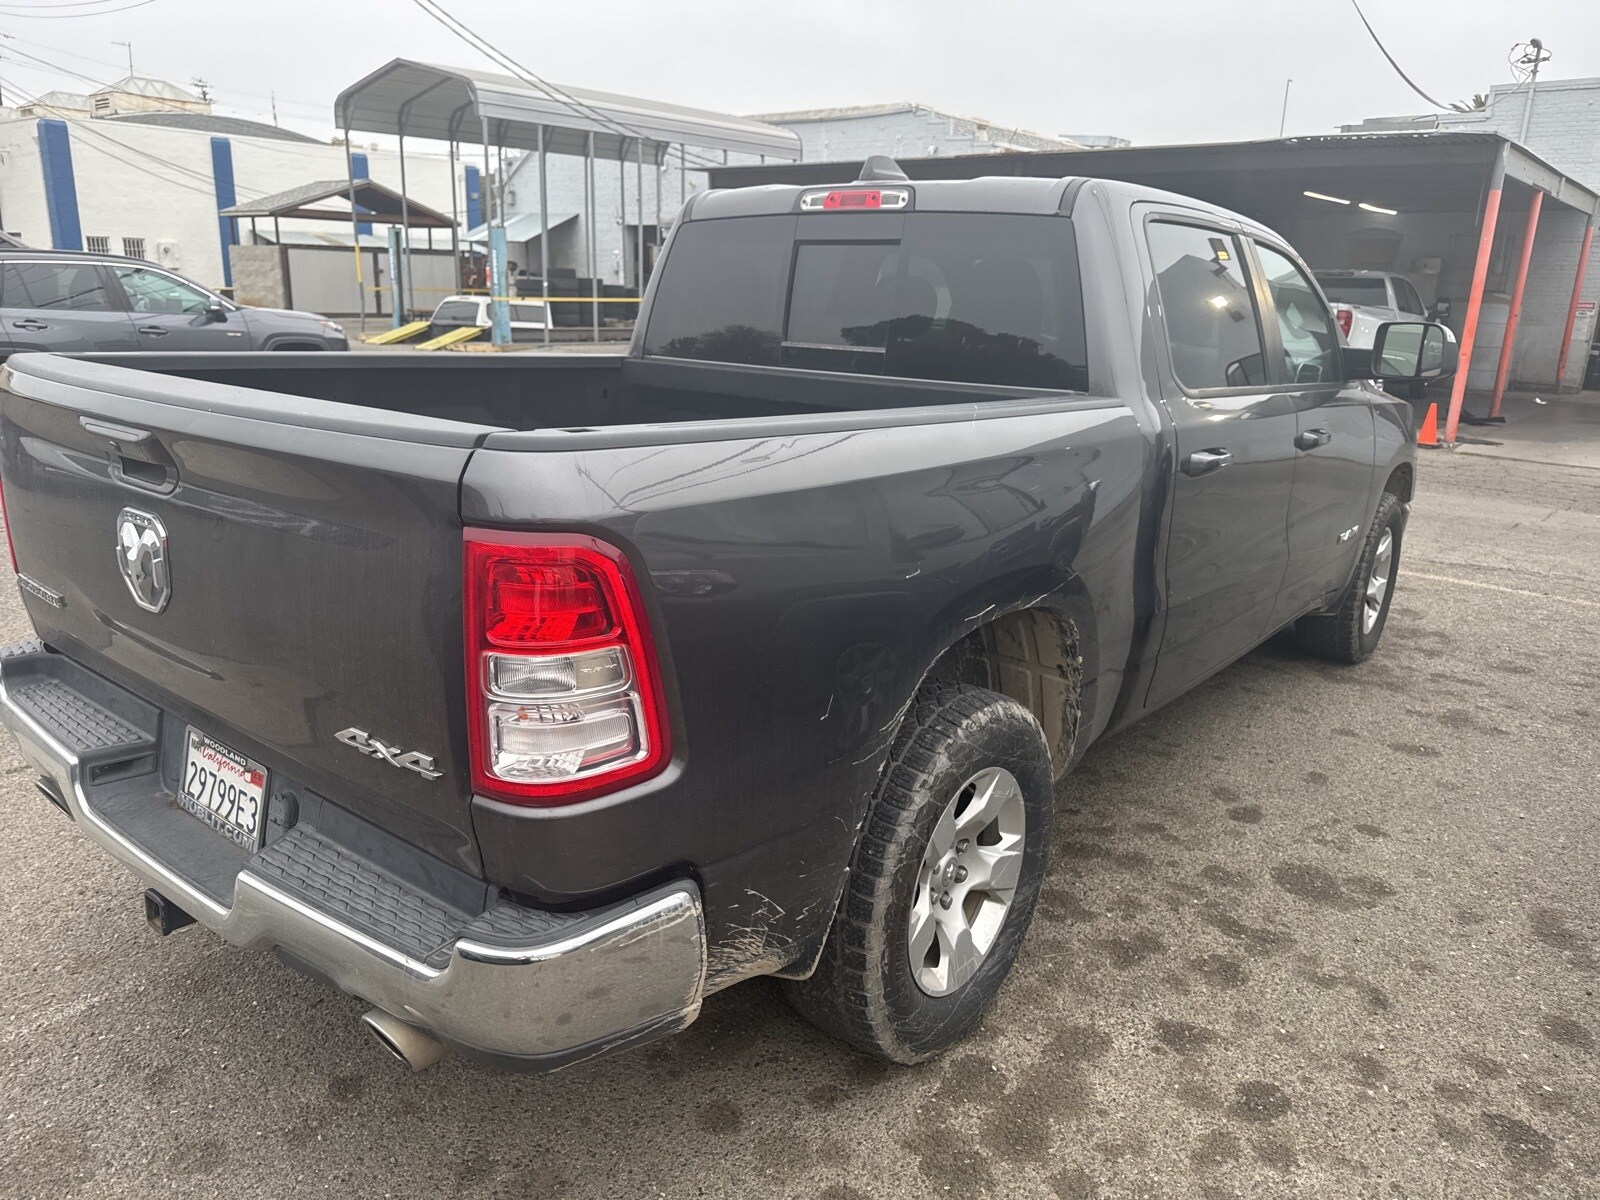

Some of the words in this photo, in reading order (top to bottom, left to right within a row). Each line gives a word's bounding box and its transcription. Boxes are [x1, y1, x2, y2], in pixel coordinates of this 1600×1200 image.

[202, 745, 246, 777] California
[203, 736, 247, 766] WOODLAND
[187, 760, 259, 834] 29799E3
